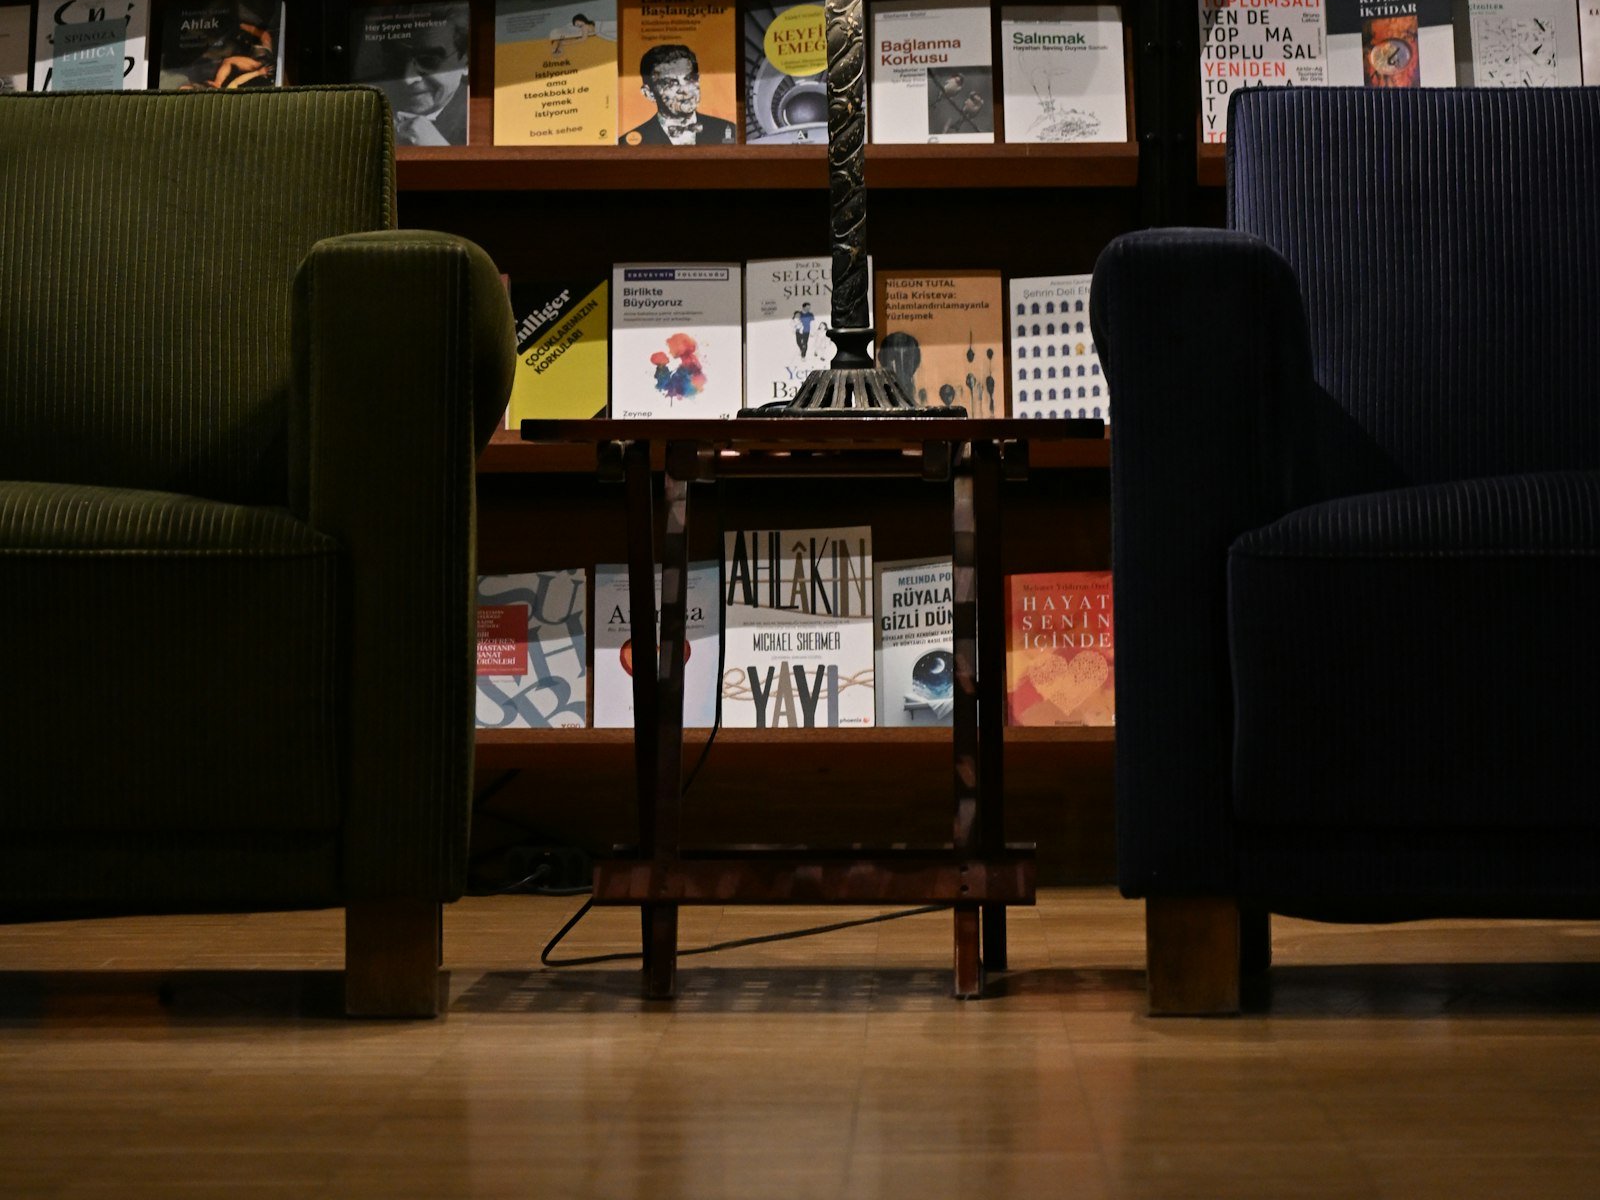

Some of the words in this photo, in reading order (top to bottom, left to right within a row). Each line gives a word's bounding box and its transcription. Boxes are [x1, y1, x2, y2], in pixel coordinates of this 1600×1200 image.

[641, 4, 728, 18] Başlangıçlar
[1203, 10, 1237, 25] YEN
[1248, 10, 1270, 25] DE
[1359, 3, 1417, 18] İKTİDAR
[180, 19, 220, 31] Ahlak
[365, 24, 380, 32] Her
[414, 18, 448, 29] Herkese
[387, 32, 412, 41] Lacan
[774, 24, 824, 43] KEYFİ
[1013, 32, 1086, 46] Salınmak
[1203, 27, 1240, 43] TOP
[1266, 27, 1293, 42] MA
[881, 37, 961, 53] Bağlanma
[1204, 44, 1264, 60] TOPLU
[1283, 44, 1317, 59] SAL
[63, 46, 116, 63] ETHICA
[881, 53, 949, 66] Korkusu
[543, 59, 571, 68] ölmek
[1205, 59, 1286, 78] YENİDEN
[535, 68, 579, 80] istiyorum
[524, 89, 576, 100] tteokbokki
[578, 86, 590, 94] de
[541, 98, 572, 109] yemek
[535, 107, 579, 119] istiyorum
[555, 125, 583, 135] sehee
[772, 269, 832, 284] SELÇU
[623, 288, 663, 297] Birlikte
[886, 291, 908, 300] Julia
[911, 292, 957, 300] Kristeva:
[1023, 289, 1054, 300] Şehrin
[1056, 287, 1075, 297] Deli
[623, 298, 683, 310] Büyüyoruz
[516, 288, 571, 344] ulliger
[886, 312, 934, 321] Yüzleşmek
[525, 299, 599, 367] ÇOCUKLARIMIZIN
[534, 329, 584, 375] KORKULARI
[727, 529, 866, 619] AHLÂKIN
[898, 576, 937, 586] MELINDA
[893, 587, 952, 609] RÜYALA
[1023, 594, 1110, 612] HAYAT
[882, 611, 920, 631] GİZLİ
[1022, 612, 1111, 631] SENİN
[477, 644, 516, 652] HASTANIN
[753, 632, 794, 652] MICHAEL
[797, 632, 841, 651] SHERMER
[1024, 631, 1112, 652] İÇİNDE
[747, 661, 839, 728] YAYI
